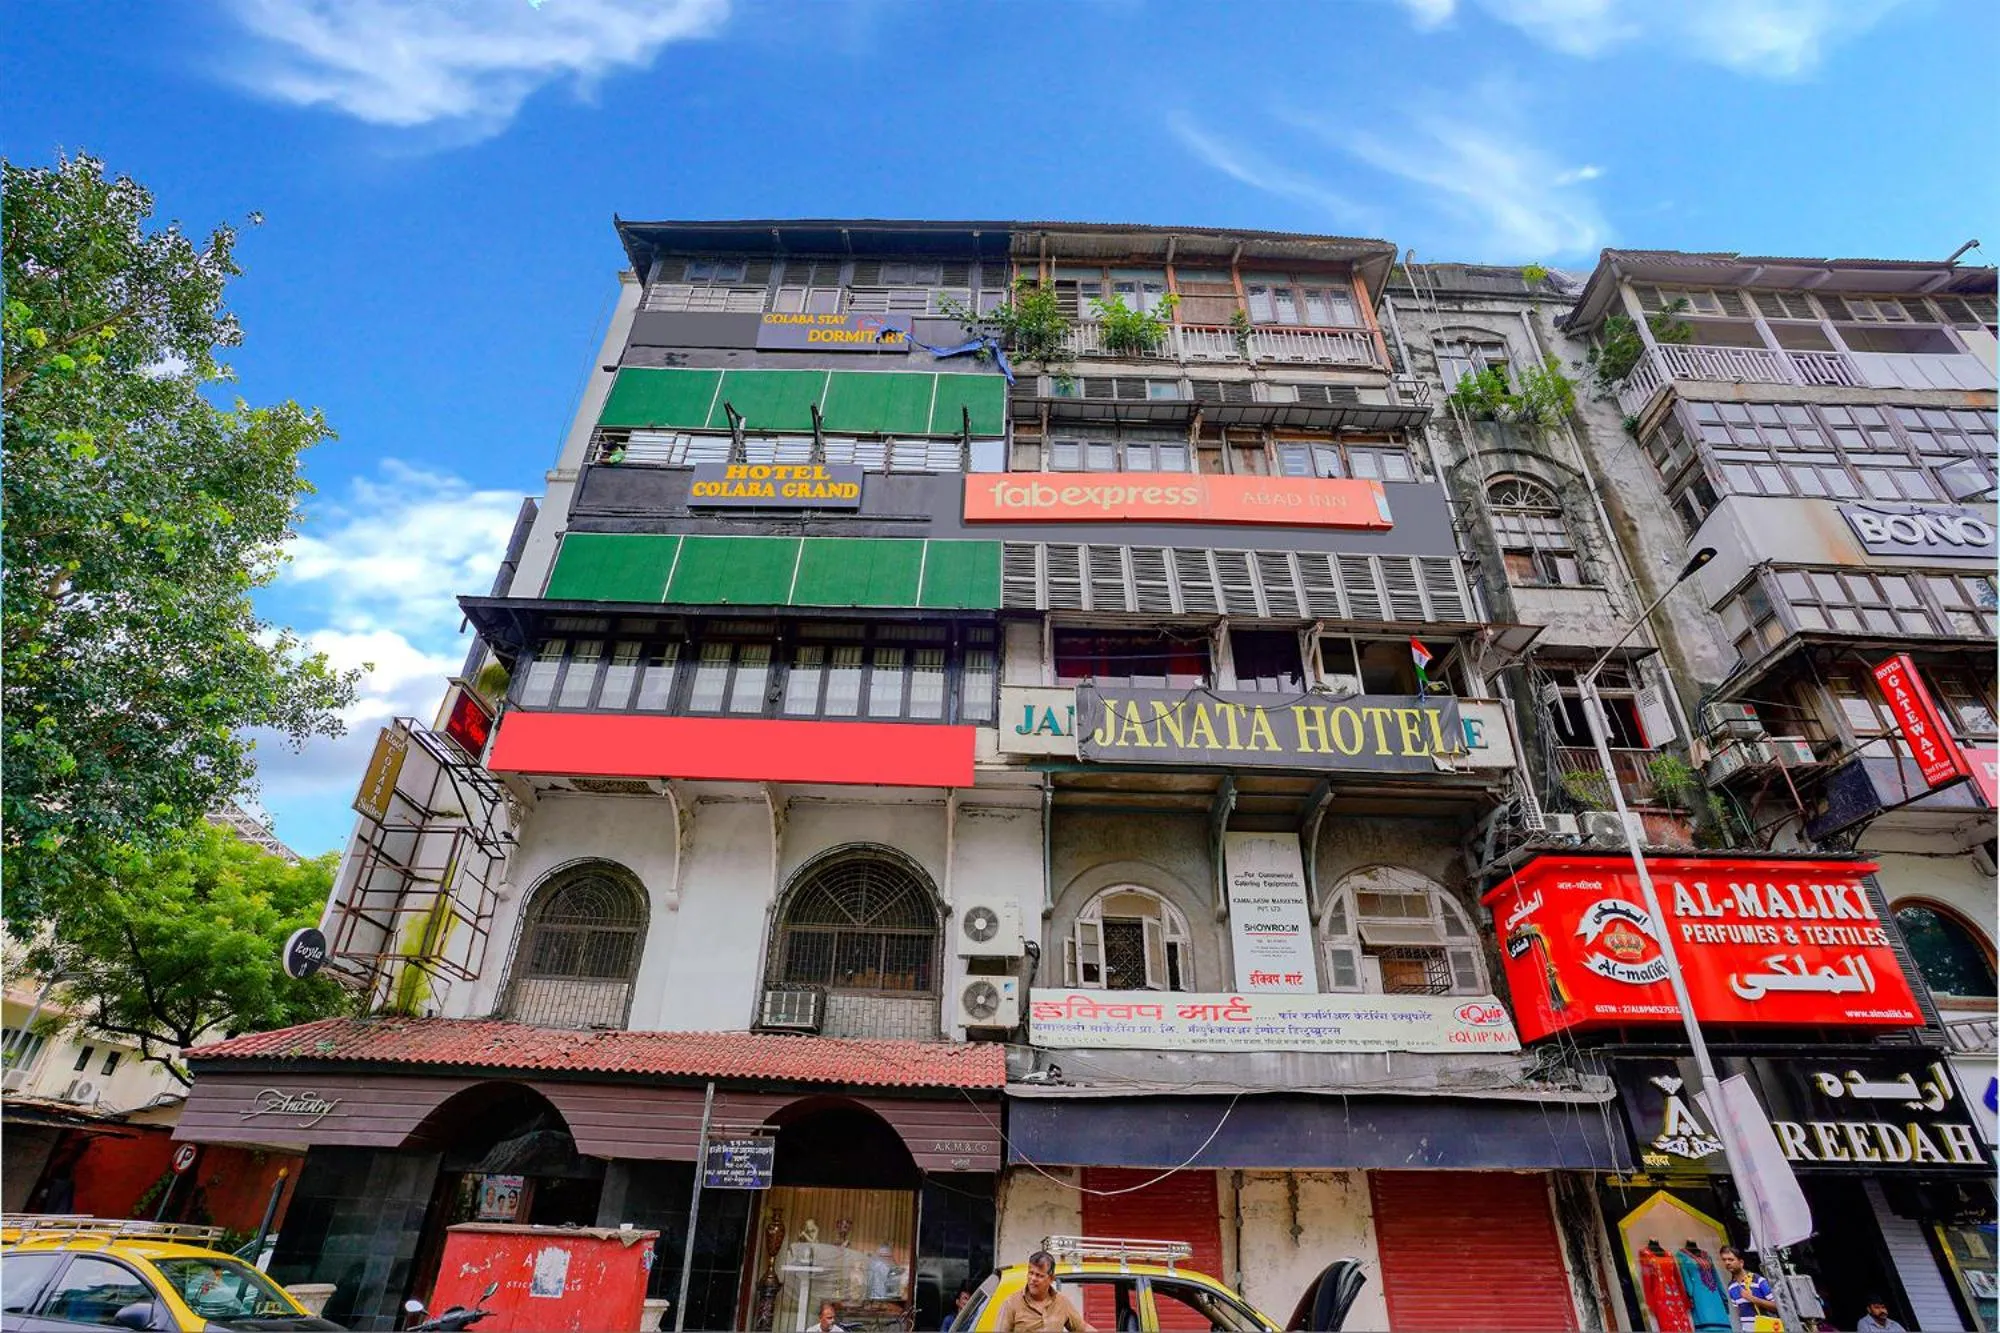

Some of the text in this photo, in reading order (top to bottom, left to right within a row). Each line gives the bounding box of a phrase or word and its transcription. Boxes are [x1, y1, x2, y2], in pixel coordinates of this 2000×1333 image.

[764, 313, 815, 325] COLABA
[818, 314, 848, 325] STAY
[808, 329, 906, 344] DORMITRY
[725, 464, 831, 481] HOTEL
[691, 481, 859, 499] COLABA GRAND
[988, 480, 1347, 511] fabexpress ABAD INN
[1850, 513, 1996, 547] BONO
[1875, 661, 1902, 681] HOTEL
[1094, 699, 1460, 756] JANATA HOTEL
[1888, 674, 1937, 762] GATEWAY
[370, 746, 394, 806] COLABA
[1673, 881, 1878, 920] AL-MALIKI
[1244, 923, 1300, 933] SHOWROOM
[1682, 924, 1890, 946] PERFUMES & TEXTILES
[1177, 996, 1253, 1022] मार्ट
[241, 1088, 344, 1128] Ancestry
[507, 1280, 532, 1289] STIC
